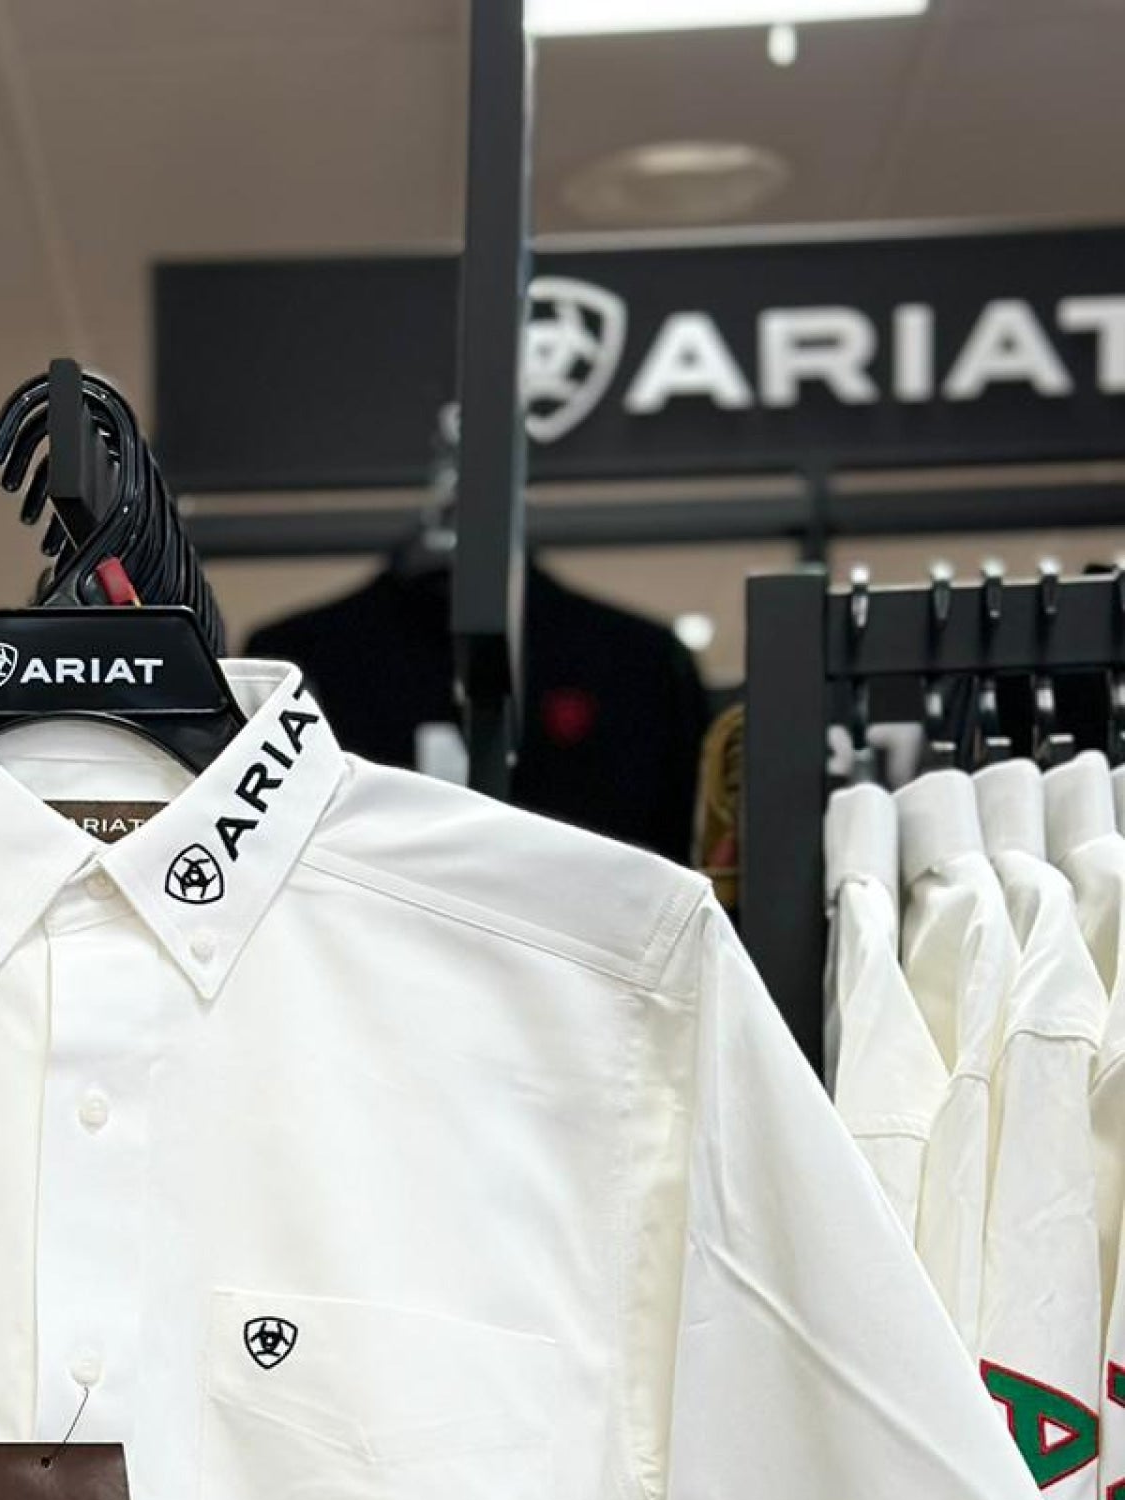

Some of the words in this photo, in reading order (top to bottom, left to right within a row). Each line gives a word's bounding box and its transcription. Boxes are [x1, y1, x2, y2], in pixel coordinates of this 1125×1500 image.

[20, 657, 164, 684] ARIAT
[215, 683, 320, 862] ARIA
[69, 817, 145, 833] RIAT
